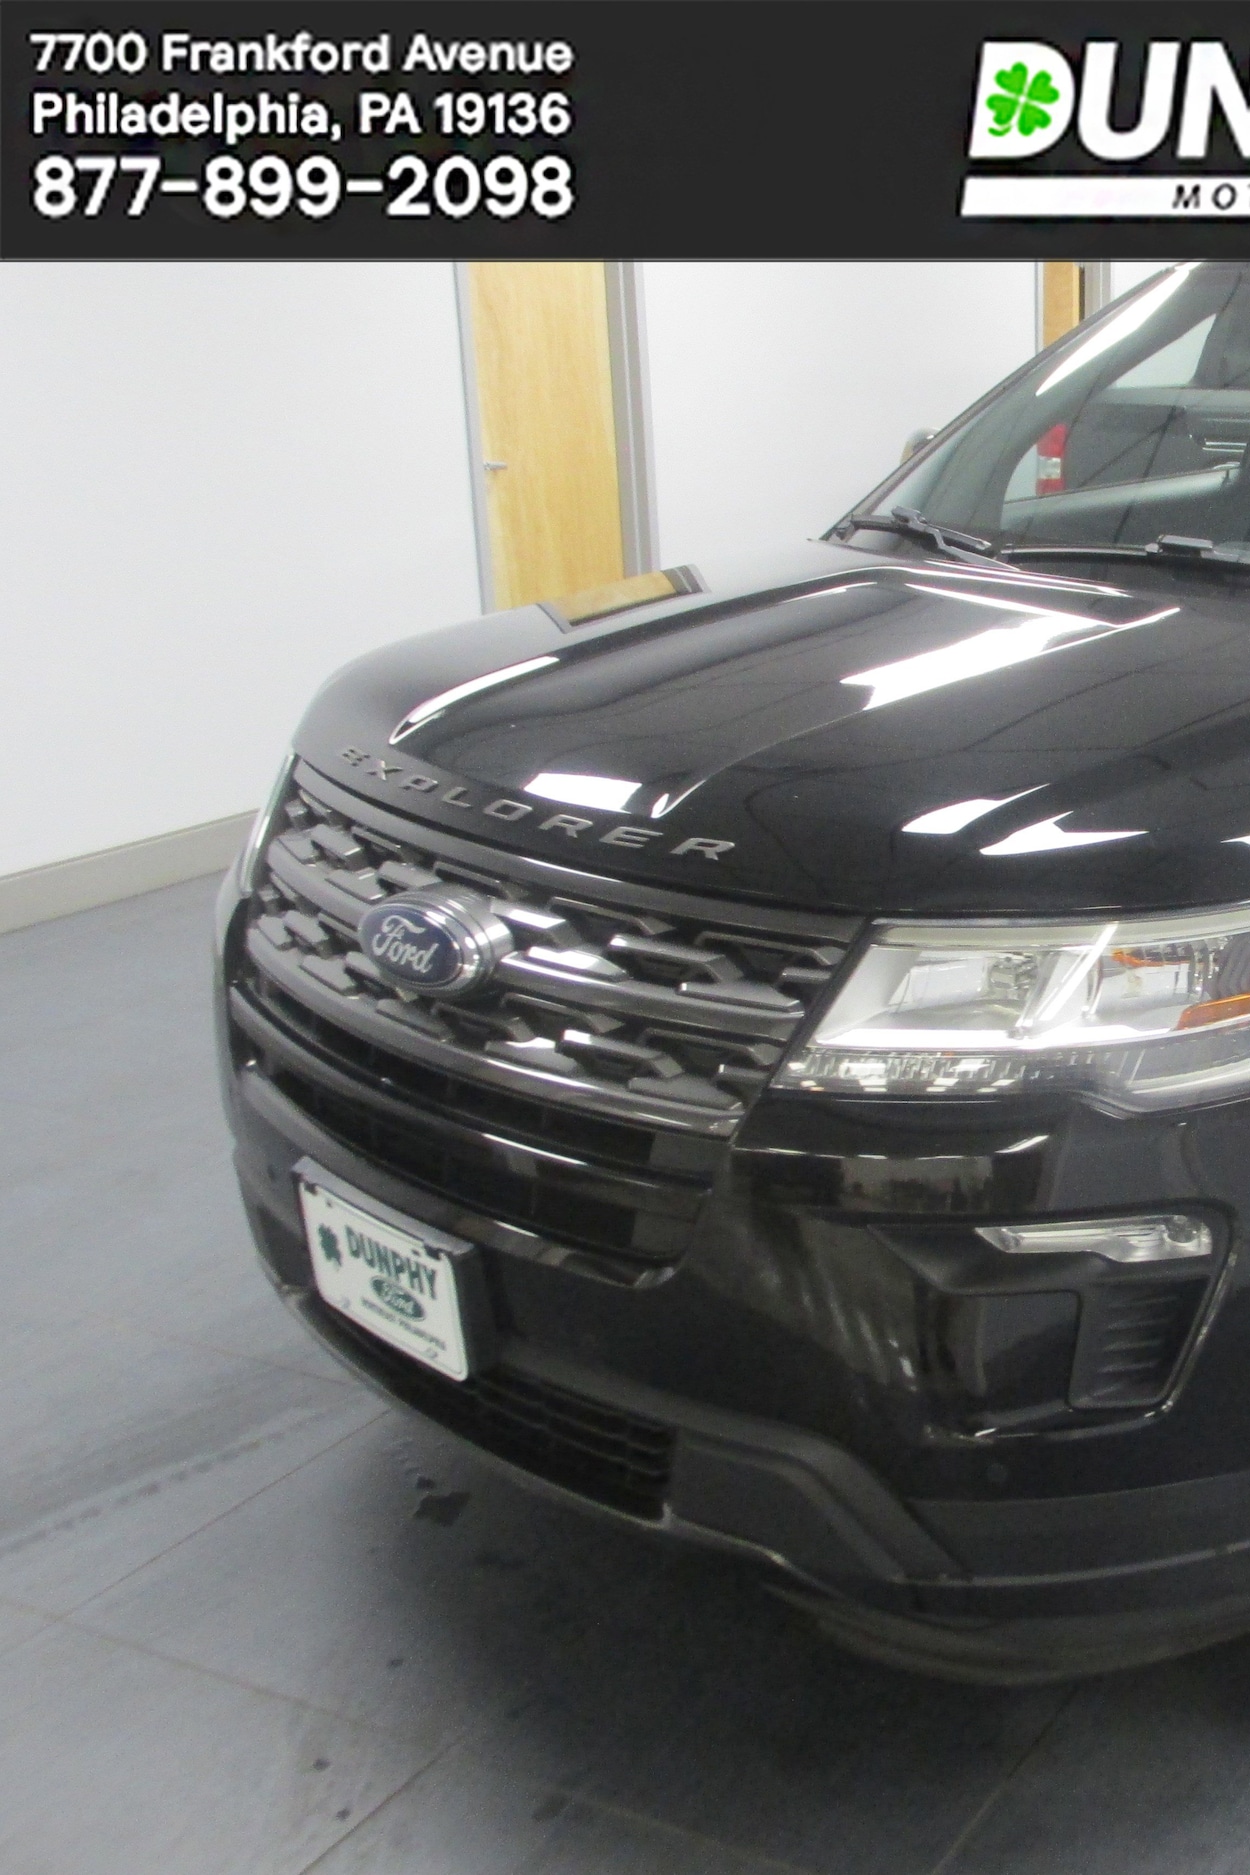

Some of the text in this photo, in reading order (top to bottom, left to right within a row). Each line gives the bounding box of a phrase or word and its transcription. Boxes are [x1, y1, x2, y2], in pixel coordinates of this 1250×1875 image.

[341, 745, 736, 861] EXPLORER
[371, 914, 436, 974] Ford
[344, 1225, 438, 1300] DUNPHY
